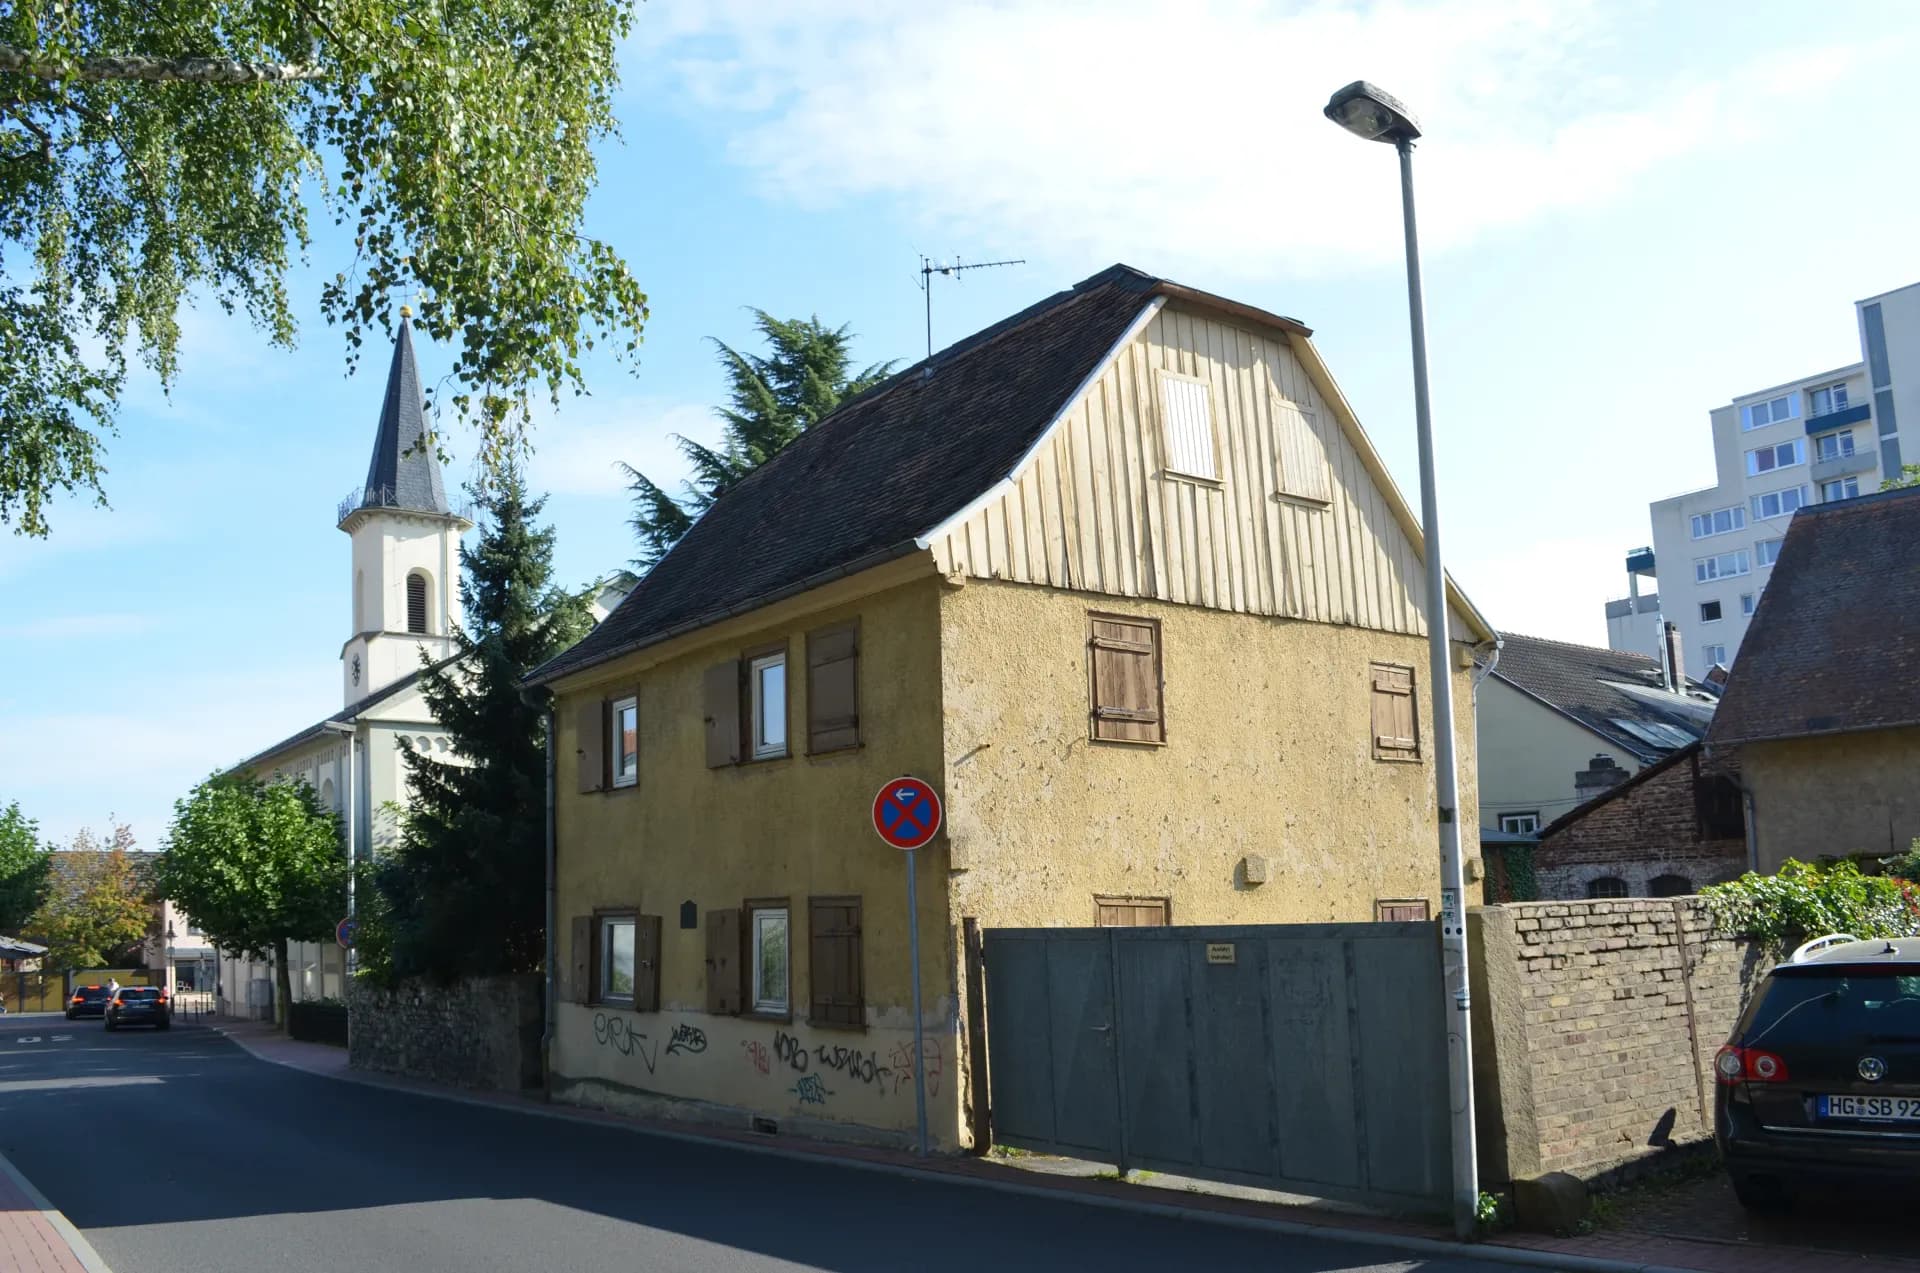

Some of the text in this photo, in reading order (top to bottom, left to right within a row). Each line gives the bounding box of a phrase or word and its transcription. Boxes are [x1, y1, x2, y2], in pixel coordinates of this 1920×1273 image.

[1829, 1097, 1920, 1118] HG SB 92
